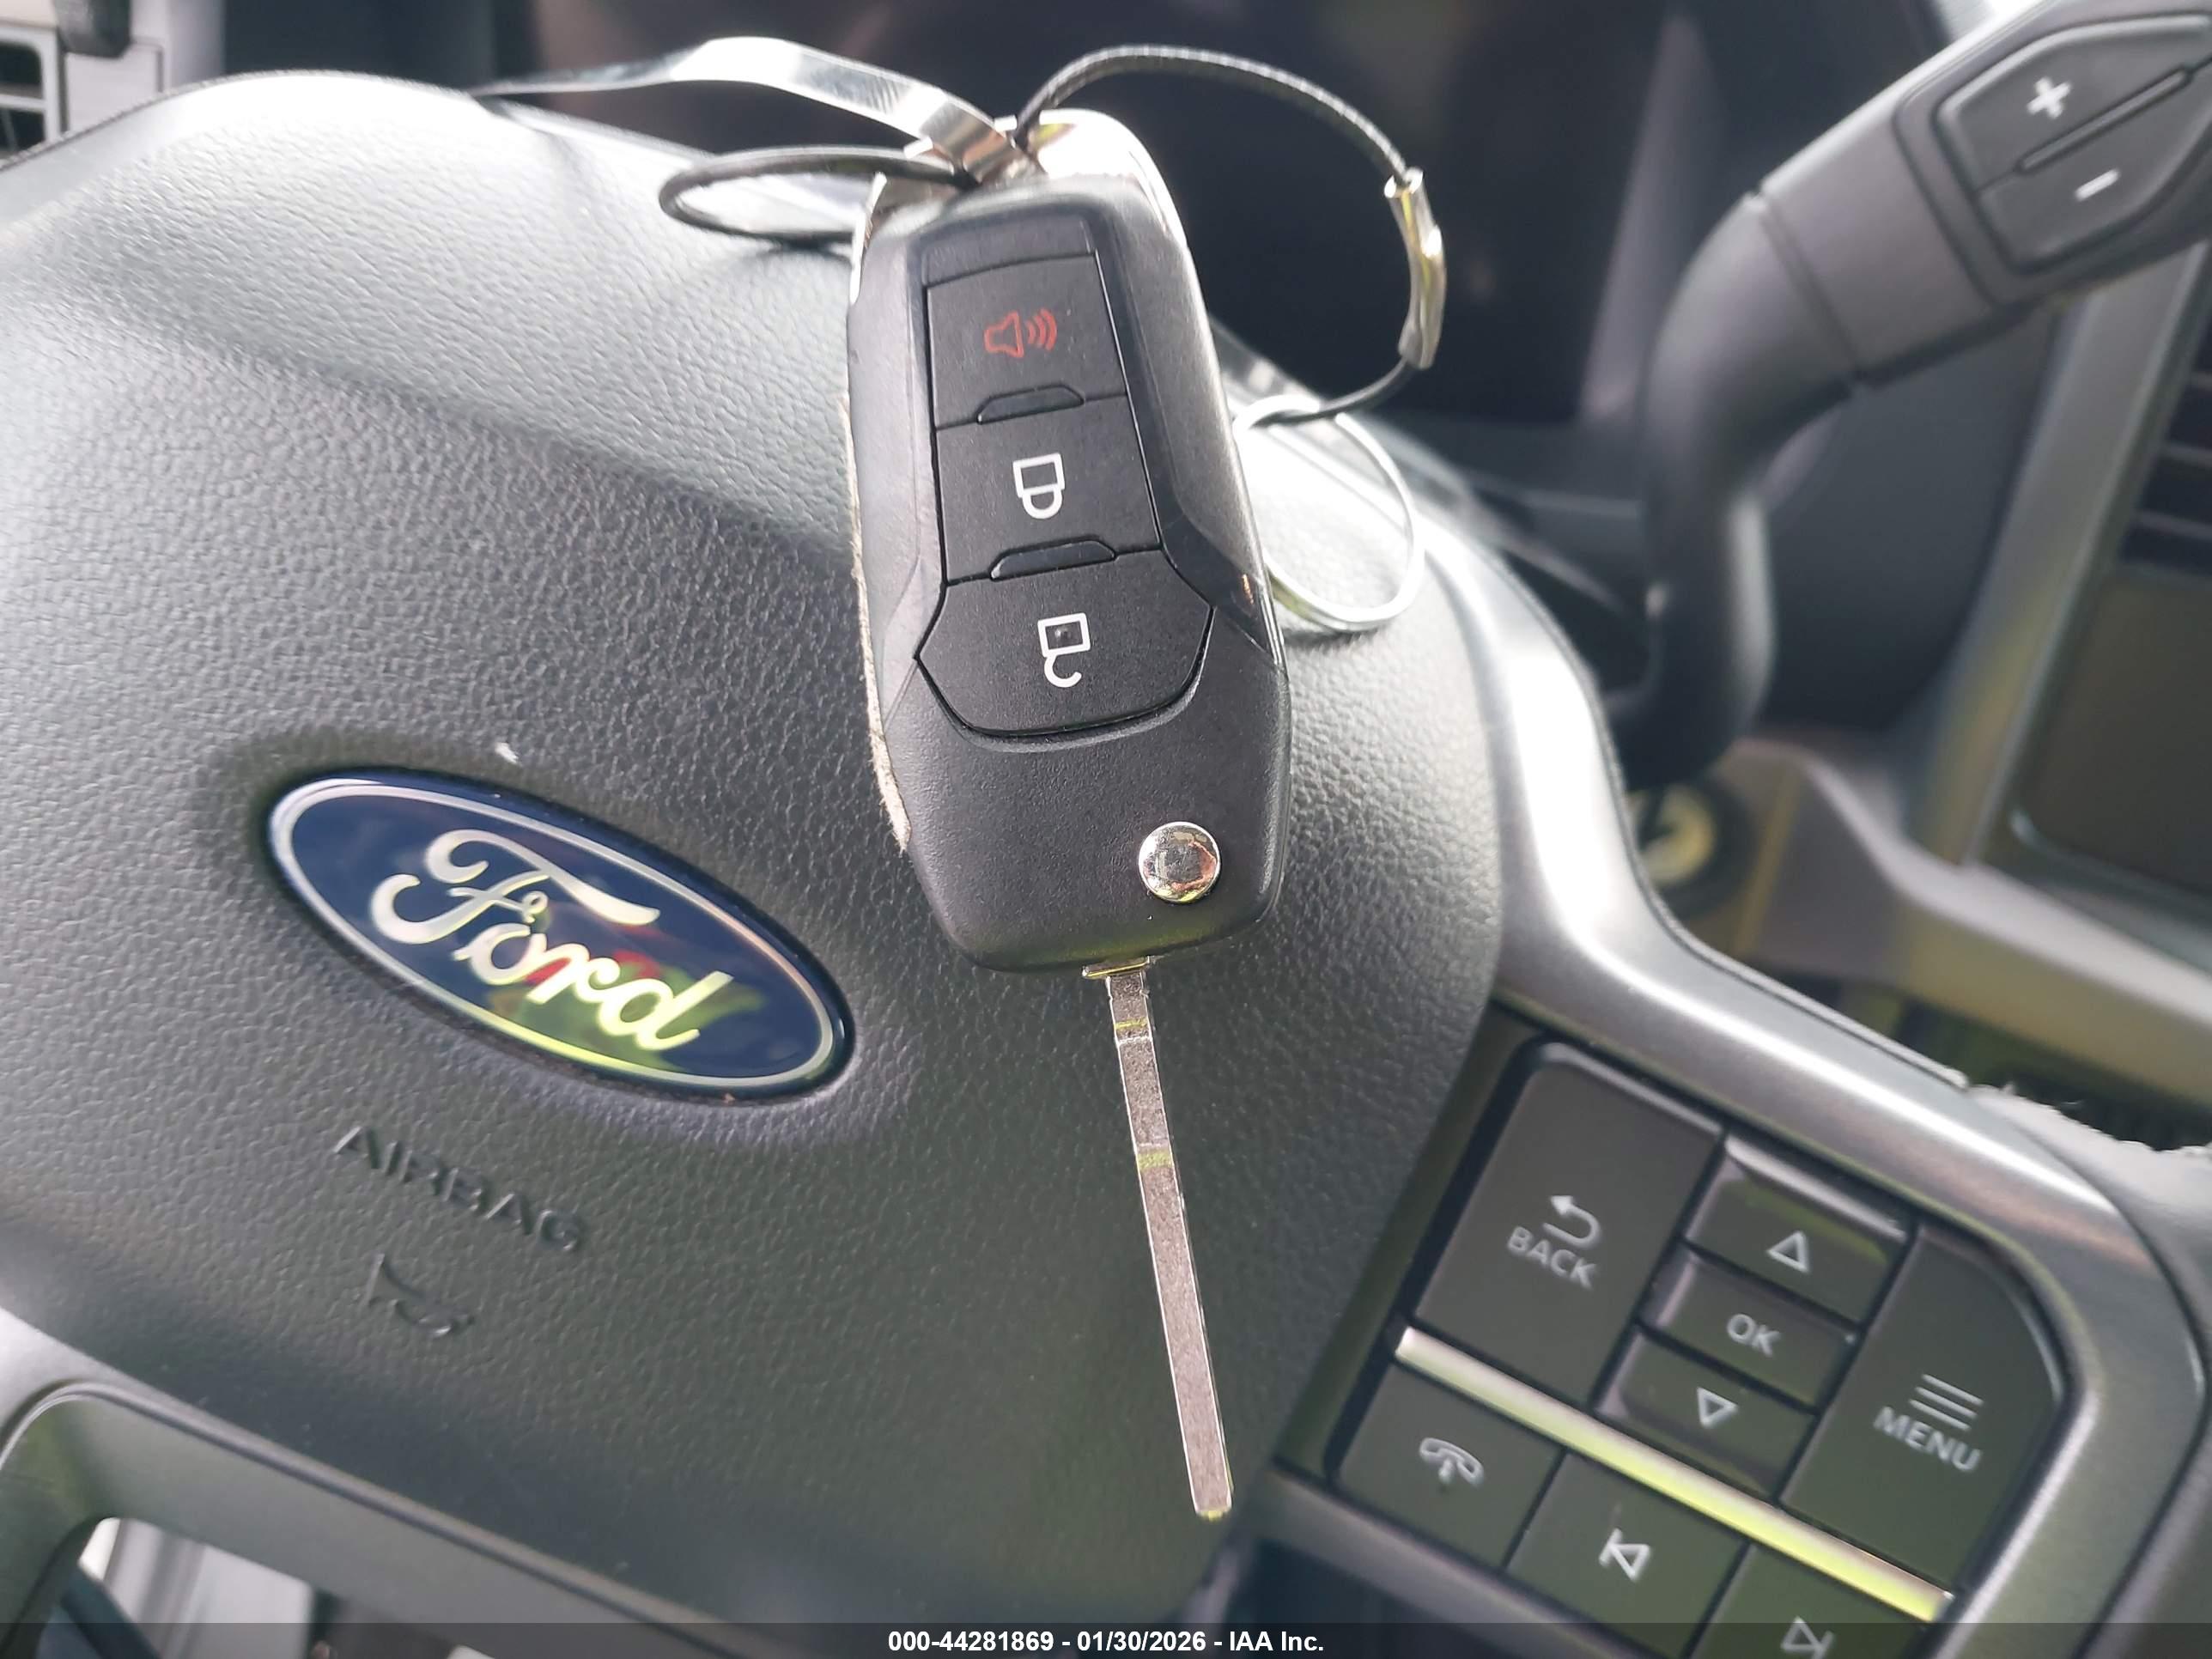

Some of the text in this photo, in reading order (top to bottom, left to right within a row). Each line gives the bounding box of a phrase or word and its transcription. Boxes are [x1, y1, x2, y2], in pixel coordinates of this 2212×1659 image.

[370, 829, 734, 1051] Ford
[333, 1126, 585, 1252] AIRBAG
[1506, 1225, 1597, 1288] BACK
[1726, 1313, 1780, 1355] OK
[1874, 1406, 1982, 1472] MENU
